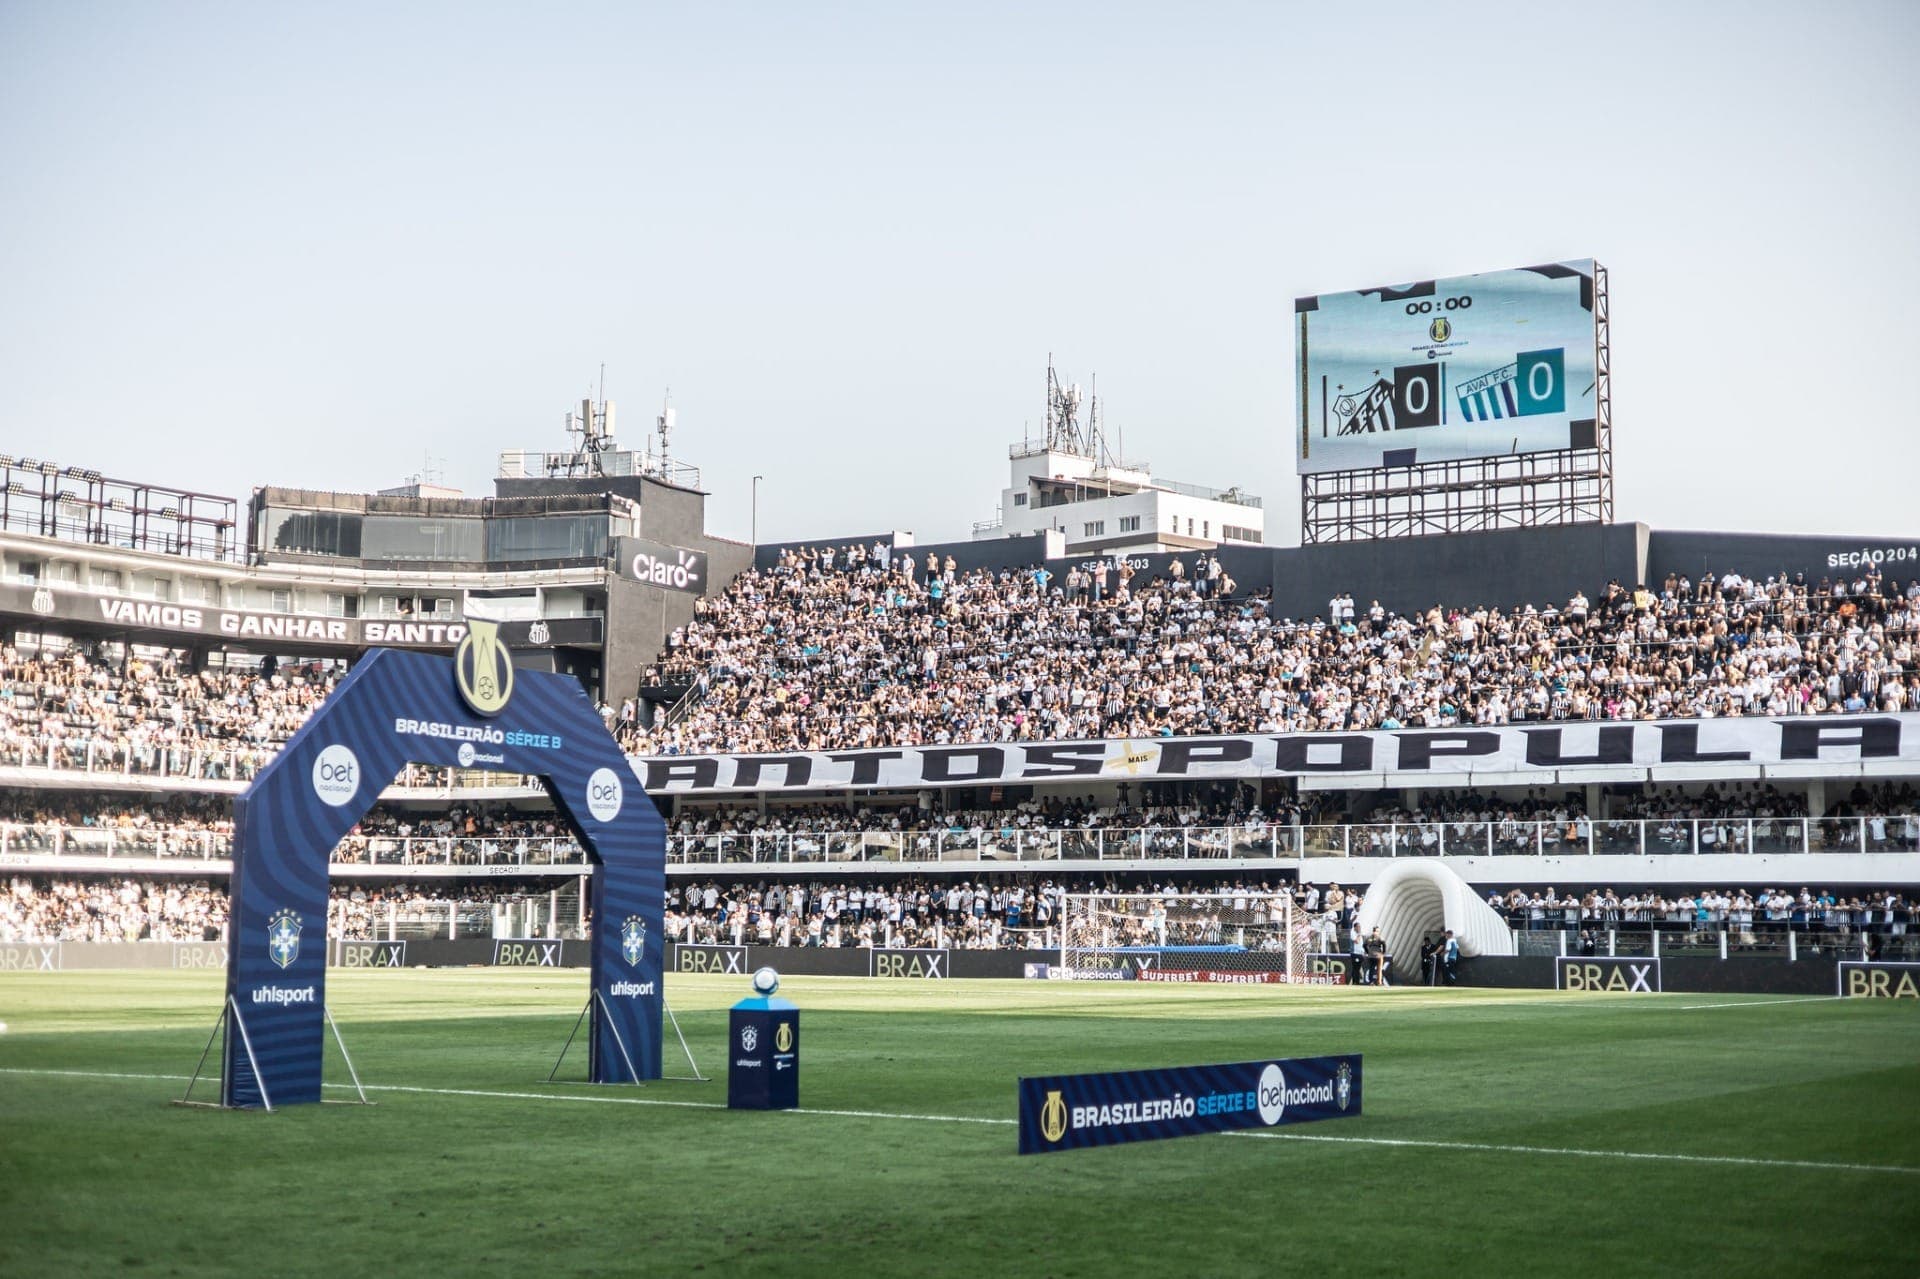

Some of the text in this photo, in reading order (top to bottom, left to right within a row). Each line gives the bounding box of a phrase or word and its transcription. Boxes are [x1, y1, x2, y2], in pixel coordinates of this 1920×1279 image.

[1529, 362, 1553, 400] 0
[1406, 376, 1429, 414] 0
[1127, 559, 1150, 570] 203
[1828, 547, 1918, 568] SEÇÃO 204
[632, 553, 690, 588] Claro
[100, 599, 202, 629] VAMOS
[220, 613, 347, 640] GANHAR
[395, 718, 562, 749] BRASILEIRÃO SÉRIE B
[320, 758, 353, 783] bet
[1128, 755, 1148, 763] MAIS
[592, 780, 617, 801] bet
[344, 946, 401, 968] BRAX
[499, 944, 556, 967] BRAX
[680, 949, 740, 974] BRAX
[876, 953, 942, 979] BRAX
[1142, 970, 1200, 982] SUPERBET
[1209, 972, 1270, 984] SUPERBET
[1566, 964, 1652, 993] BRAX
[1850, 969, 1920, 998] BRA
[252, 986, 314, 1007] uhlsport
[611, 981, 654, 999] uhlsport
[1072, 1079, 1333, 1128] BRASILEIRÃO SÉRIE B bet nacional
